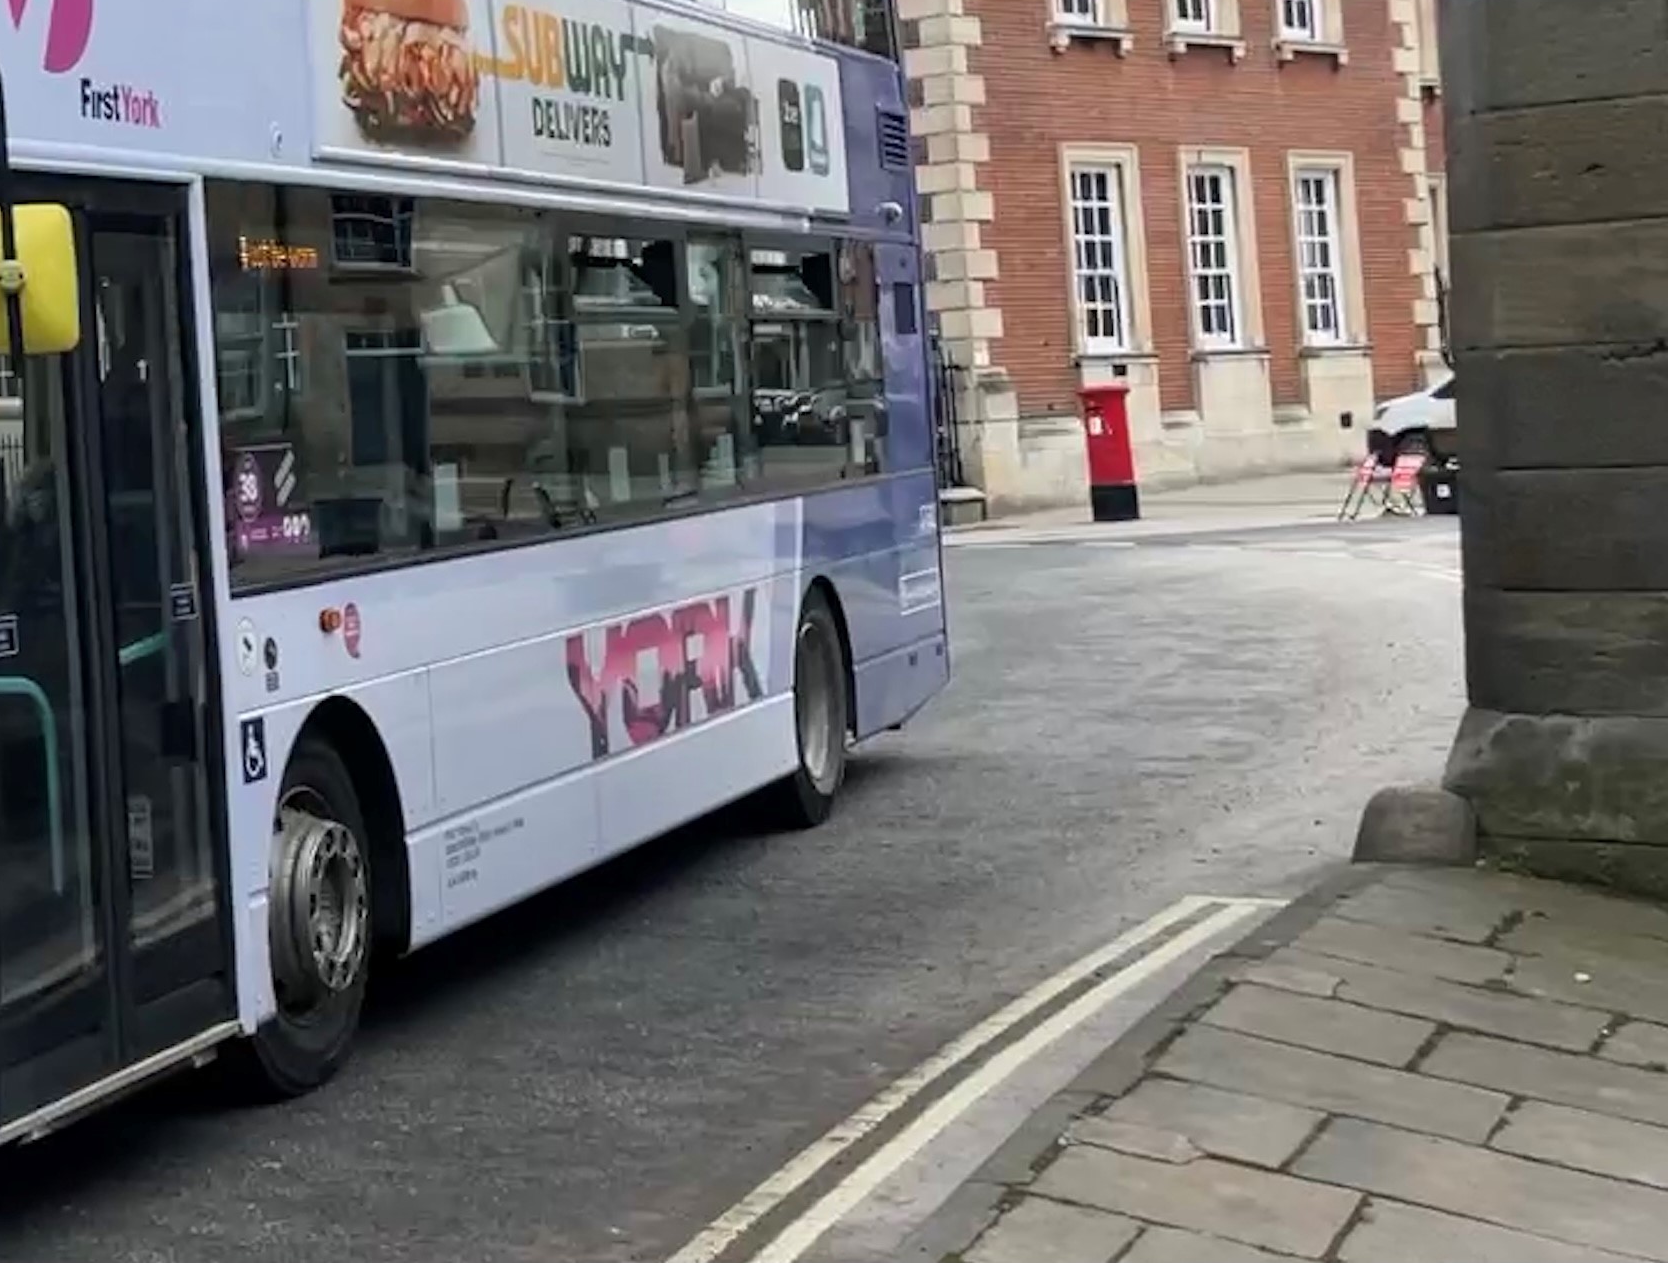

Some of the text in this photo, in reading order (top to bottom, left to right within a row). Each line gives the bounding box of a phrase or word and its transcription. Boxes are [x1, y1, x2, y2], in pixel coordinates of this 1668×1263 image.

[500, 4, 634, 102] SUBWAY
[532, 97, 612, 148] DELIVERS
[565, 587, 764, 761] YORK
